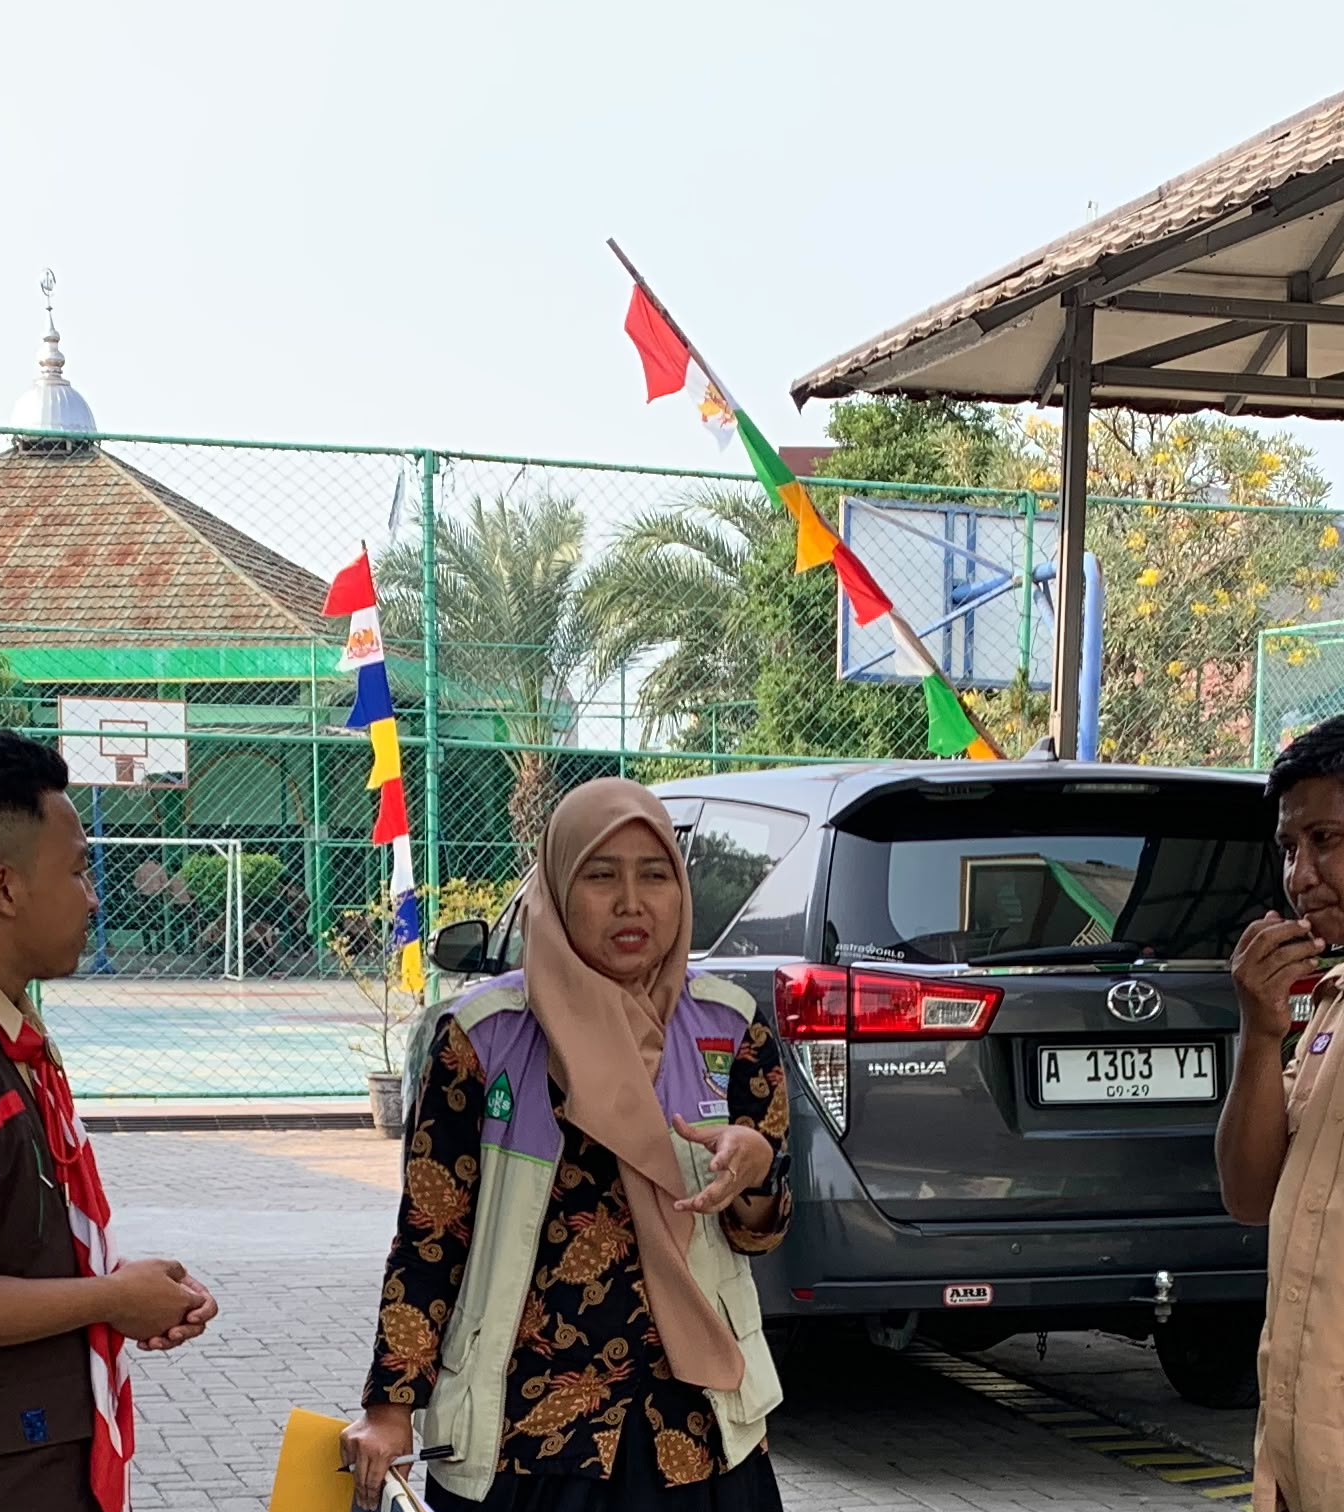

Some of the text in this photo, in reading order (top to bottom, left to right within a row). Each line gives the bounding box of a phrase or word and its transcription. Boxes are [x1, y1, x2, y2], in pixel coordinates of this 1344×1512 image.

[868, 1061, 947, 1077] INNOVA
[1046, 1047, 1208, 1083] A 1303 YI
[949, 1287, 988, 1298] ARB
